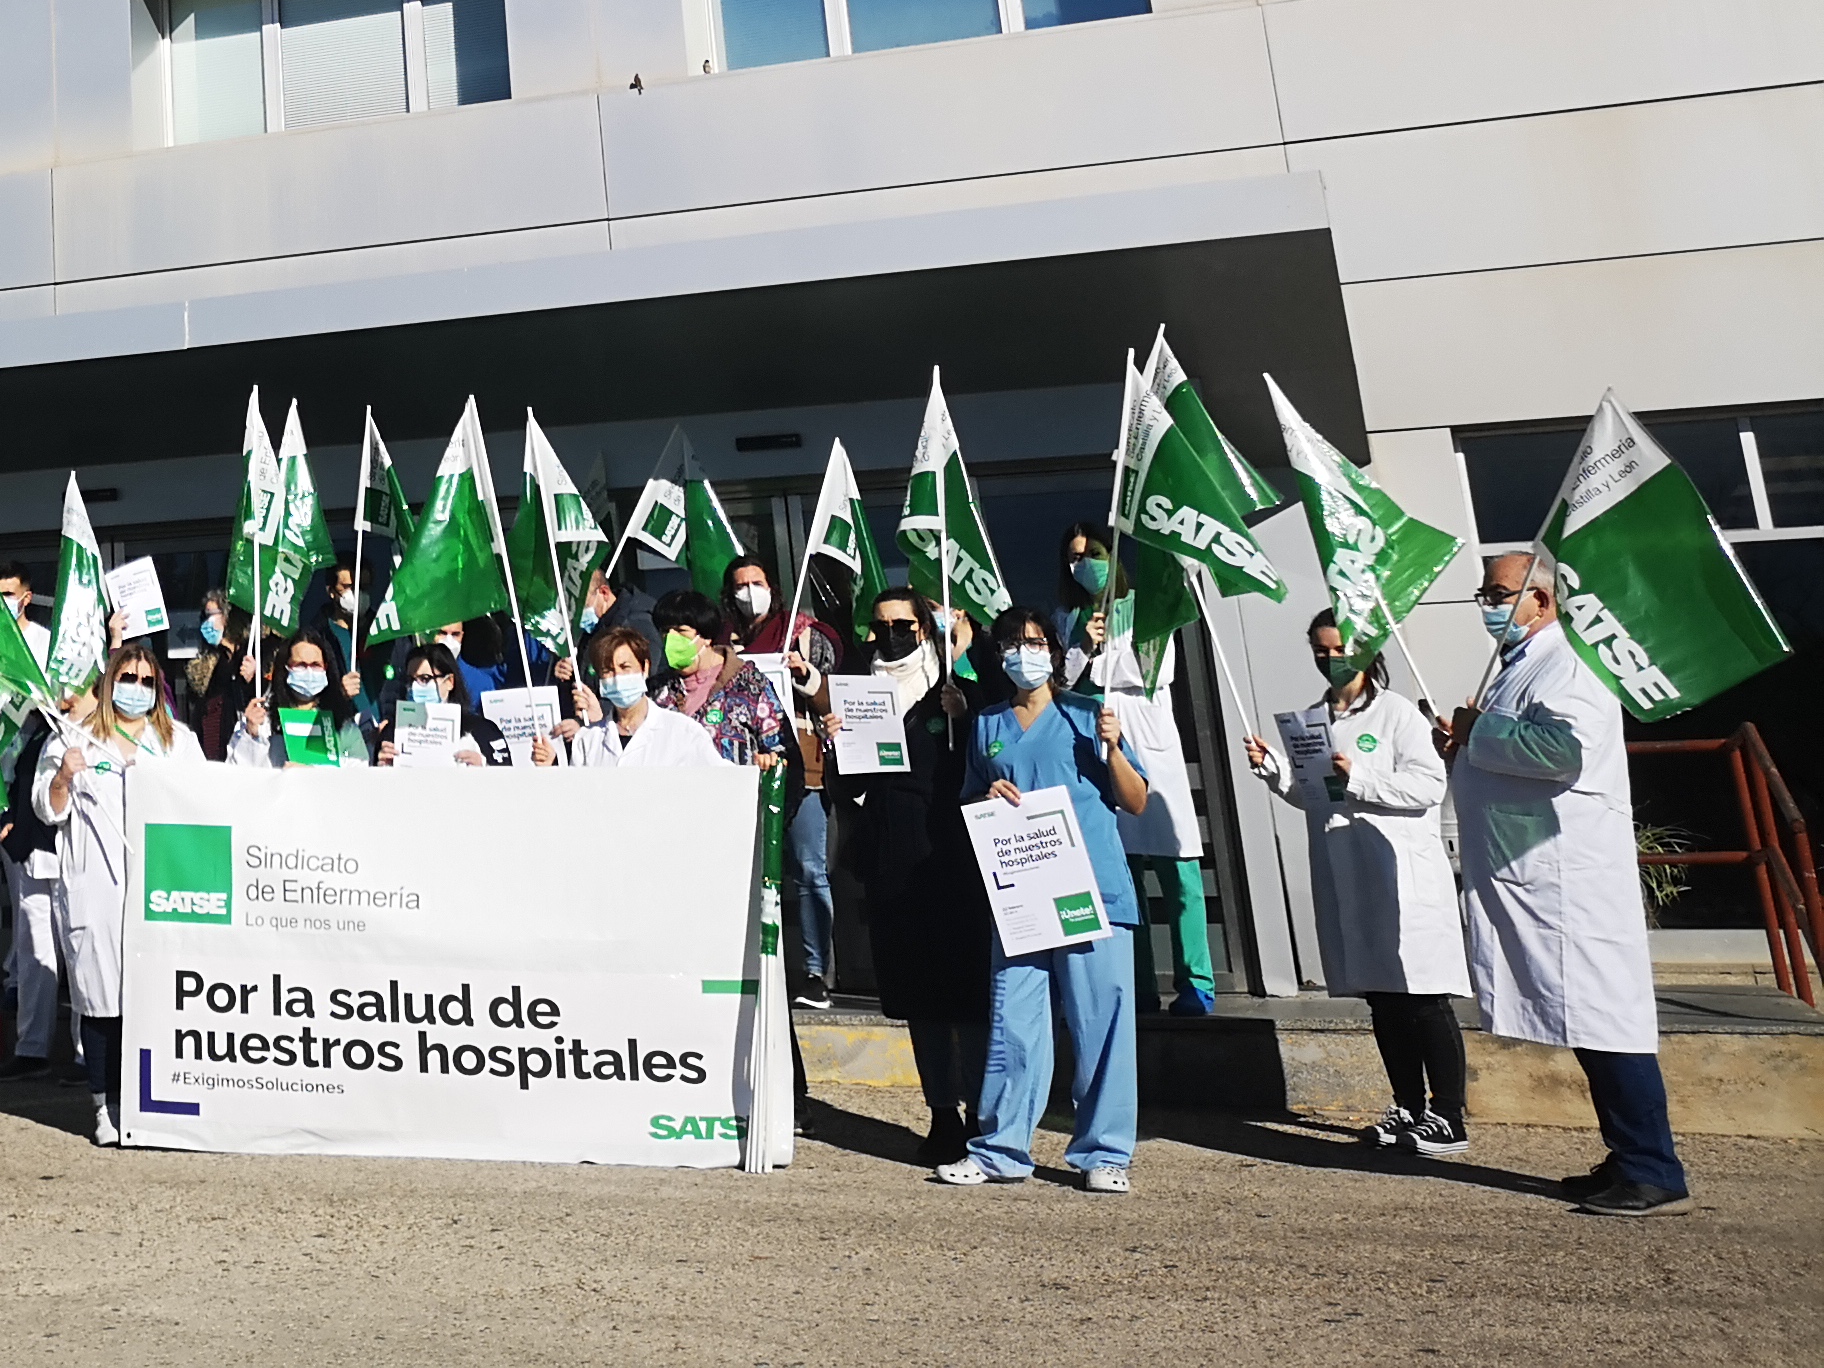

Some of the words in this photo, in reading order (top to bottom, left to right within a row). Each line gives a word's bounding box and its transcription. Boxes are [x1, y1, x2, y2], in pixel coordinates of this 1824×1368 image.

[1137, 421, 1153, 462] Castilla
[1601, 479, 1612, 494] y
[1609, 458, 1640, 484] León
[1140, 494, 1279, 590] SATSE
[992, 837, 1012, 848] Por
[1013, 833, 1026, 844] la
[1026, 825, 1058, 841] salud
[996, 848, 1012, 859] de
[1013, 837, 1064, 855] nuestros
[245, 844, 359, 875] Sindicato
[999, 850, 1058, 869] hospitales
[149, 889, 227, 915] SATSE
[245, 878, 275, 903] de
[282, 878, 420, 910] Enfermería
[245, 911, 264, 927] Lo
[270, 915, 299, 931] que
[304, 917, 331, 931] nos
[337, 918, 366, 932] une
[175, 970, 258, 1014] Por
[272, 974, 315, 1019] la
[329, 979, 474, 1027] salud
[488, 985, 561, 1030] de
[175, 1026, 404, 1072] nuestros
[417, 1030, 707, 1091] hospitales
[171, 1072, 345, 1094] #ExigimosSoluciones
[648, 1114, 750, 1141] SATS
